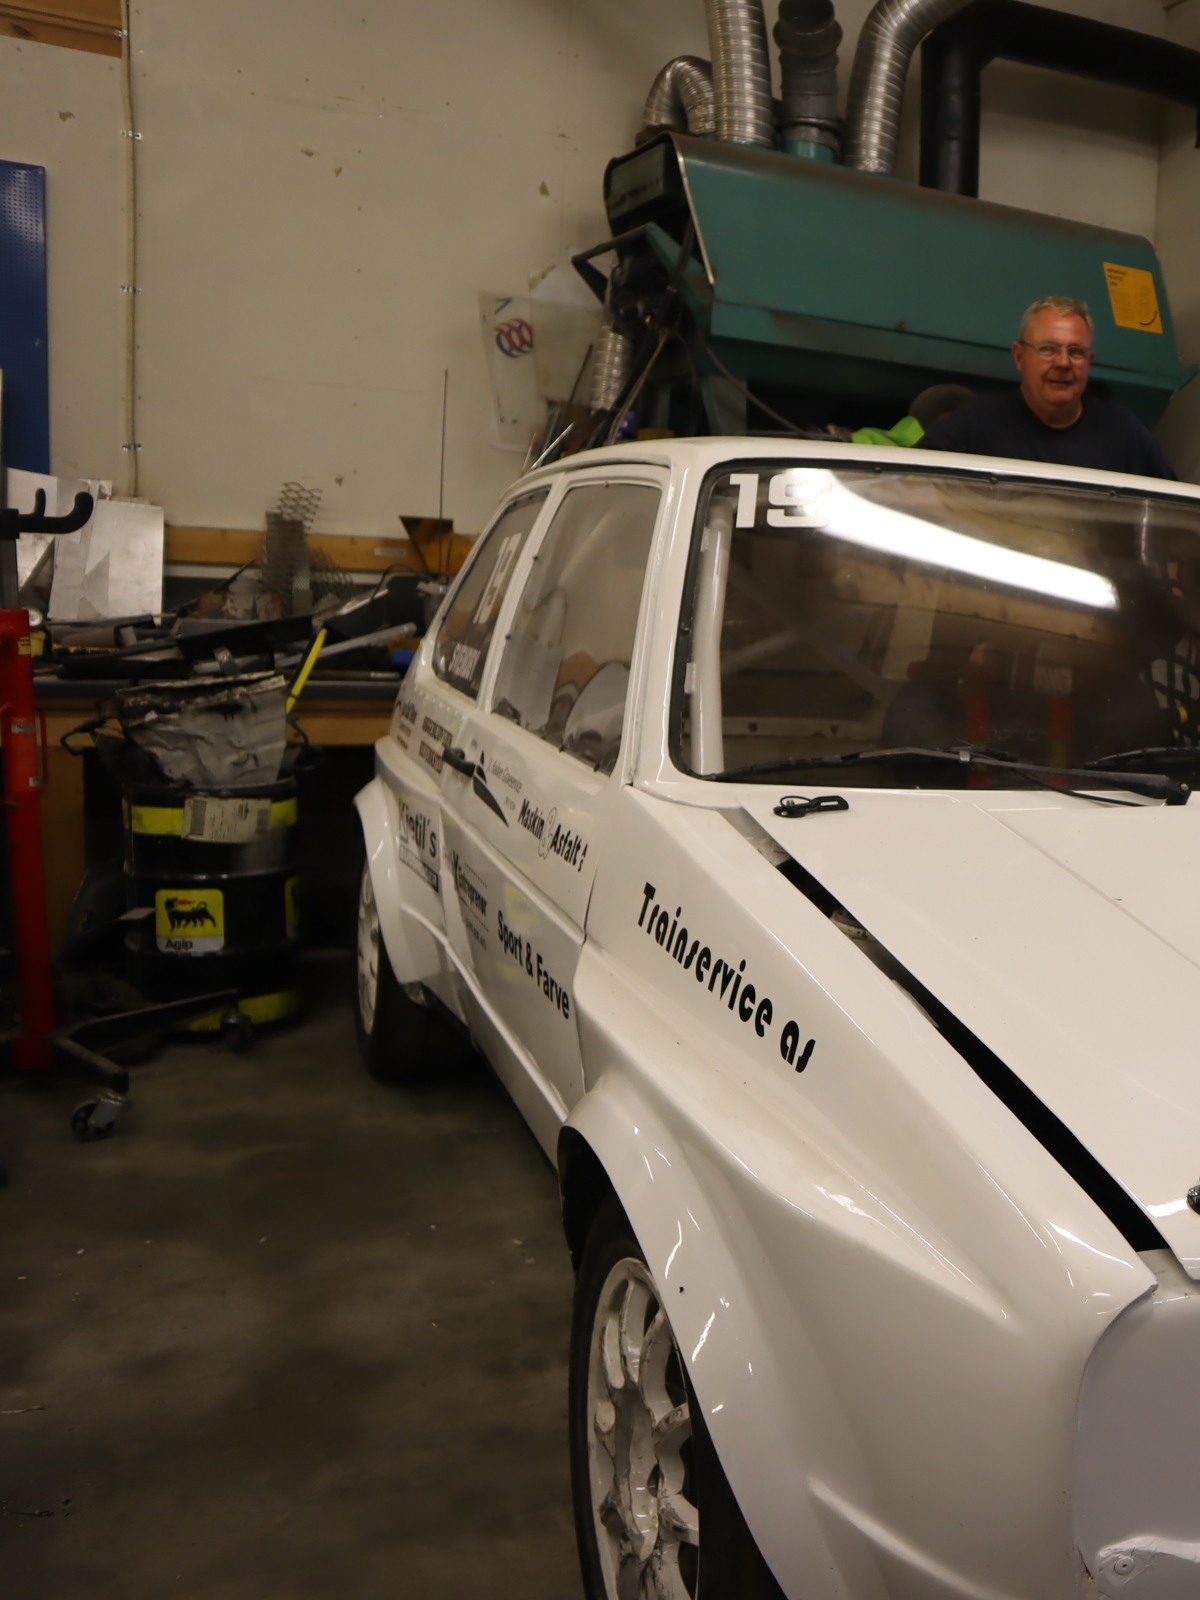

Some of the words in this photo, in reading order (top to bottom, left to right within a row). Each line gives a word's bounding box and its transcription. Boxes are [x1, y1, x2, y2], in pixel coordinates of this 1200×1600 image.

[729, 473, 832, 529] 19
[517, 797, 546, 840] Maskin
[549, 823, 583, 867] Asfalt
[164, 937, 193, 951] Agip
[497, 909, 523, 967] Sport
[525, 941, 534, 978] &
[536, 952, 570, 1021] Farve
[637, 881, 773, 1037] Trainservice
[779, 1020, 816, 1073] as
